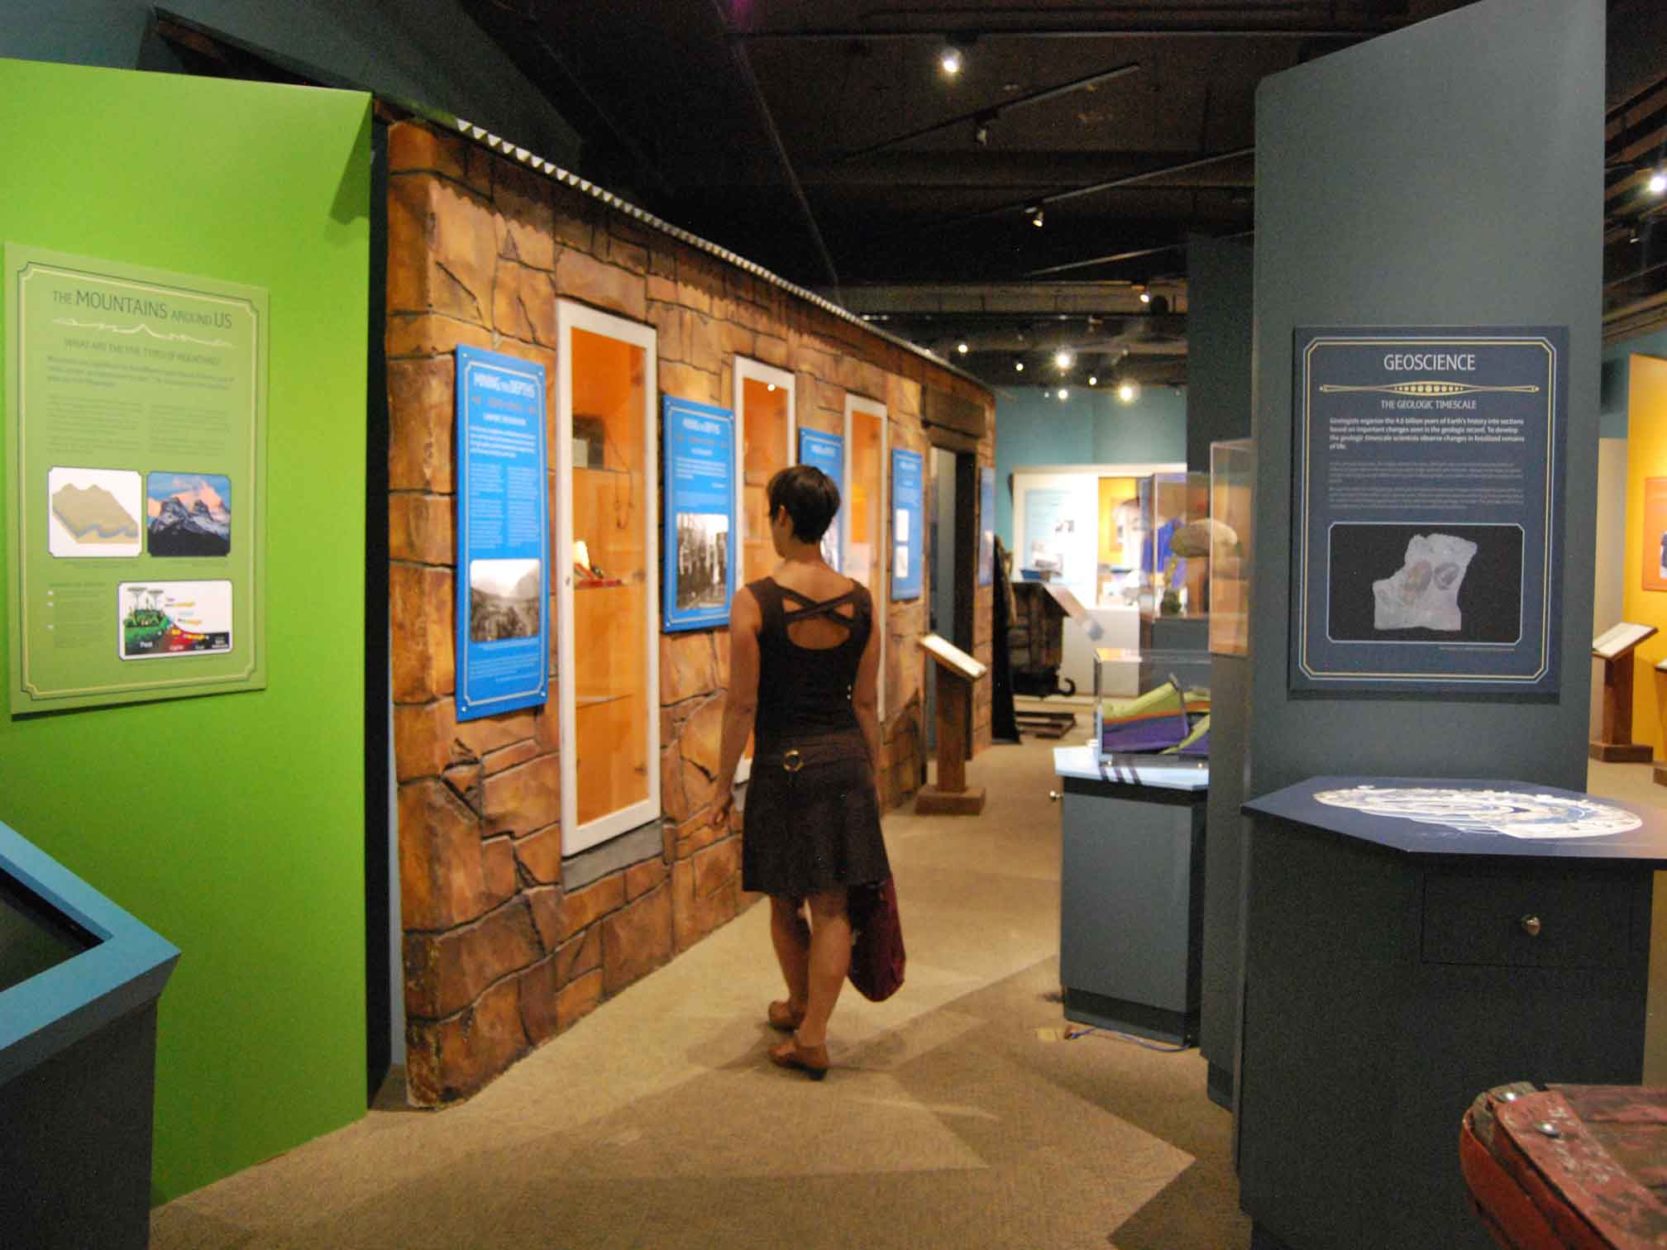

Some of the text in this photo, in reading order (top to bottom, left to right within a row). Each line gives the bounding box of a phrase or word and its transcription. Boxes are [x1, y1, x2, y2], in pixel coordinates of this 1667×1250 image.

[53, 290, 73, 304] THE
[76, 290, 167, 319] MOUNTAINS
[214, 313, 232, 329] US
[1383, 353, 1476, 371] GEOSCIENCE
[1381, 399, 1477, 410] THE GEOLOGIC TIMESCALE
